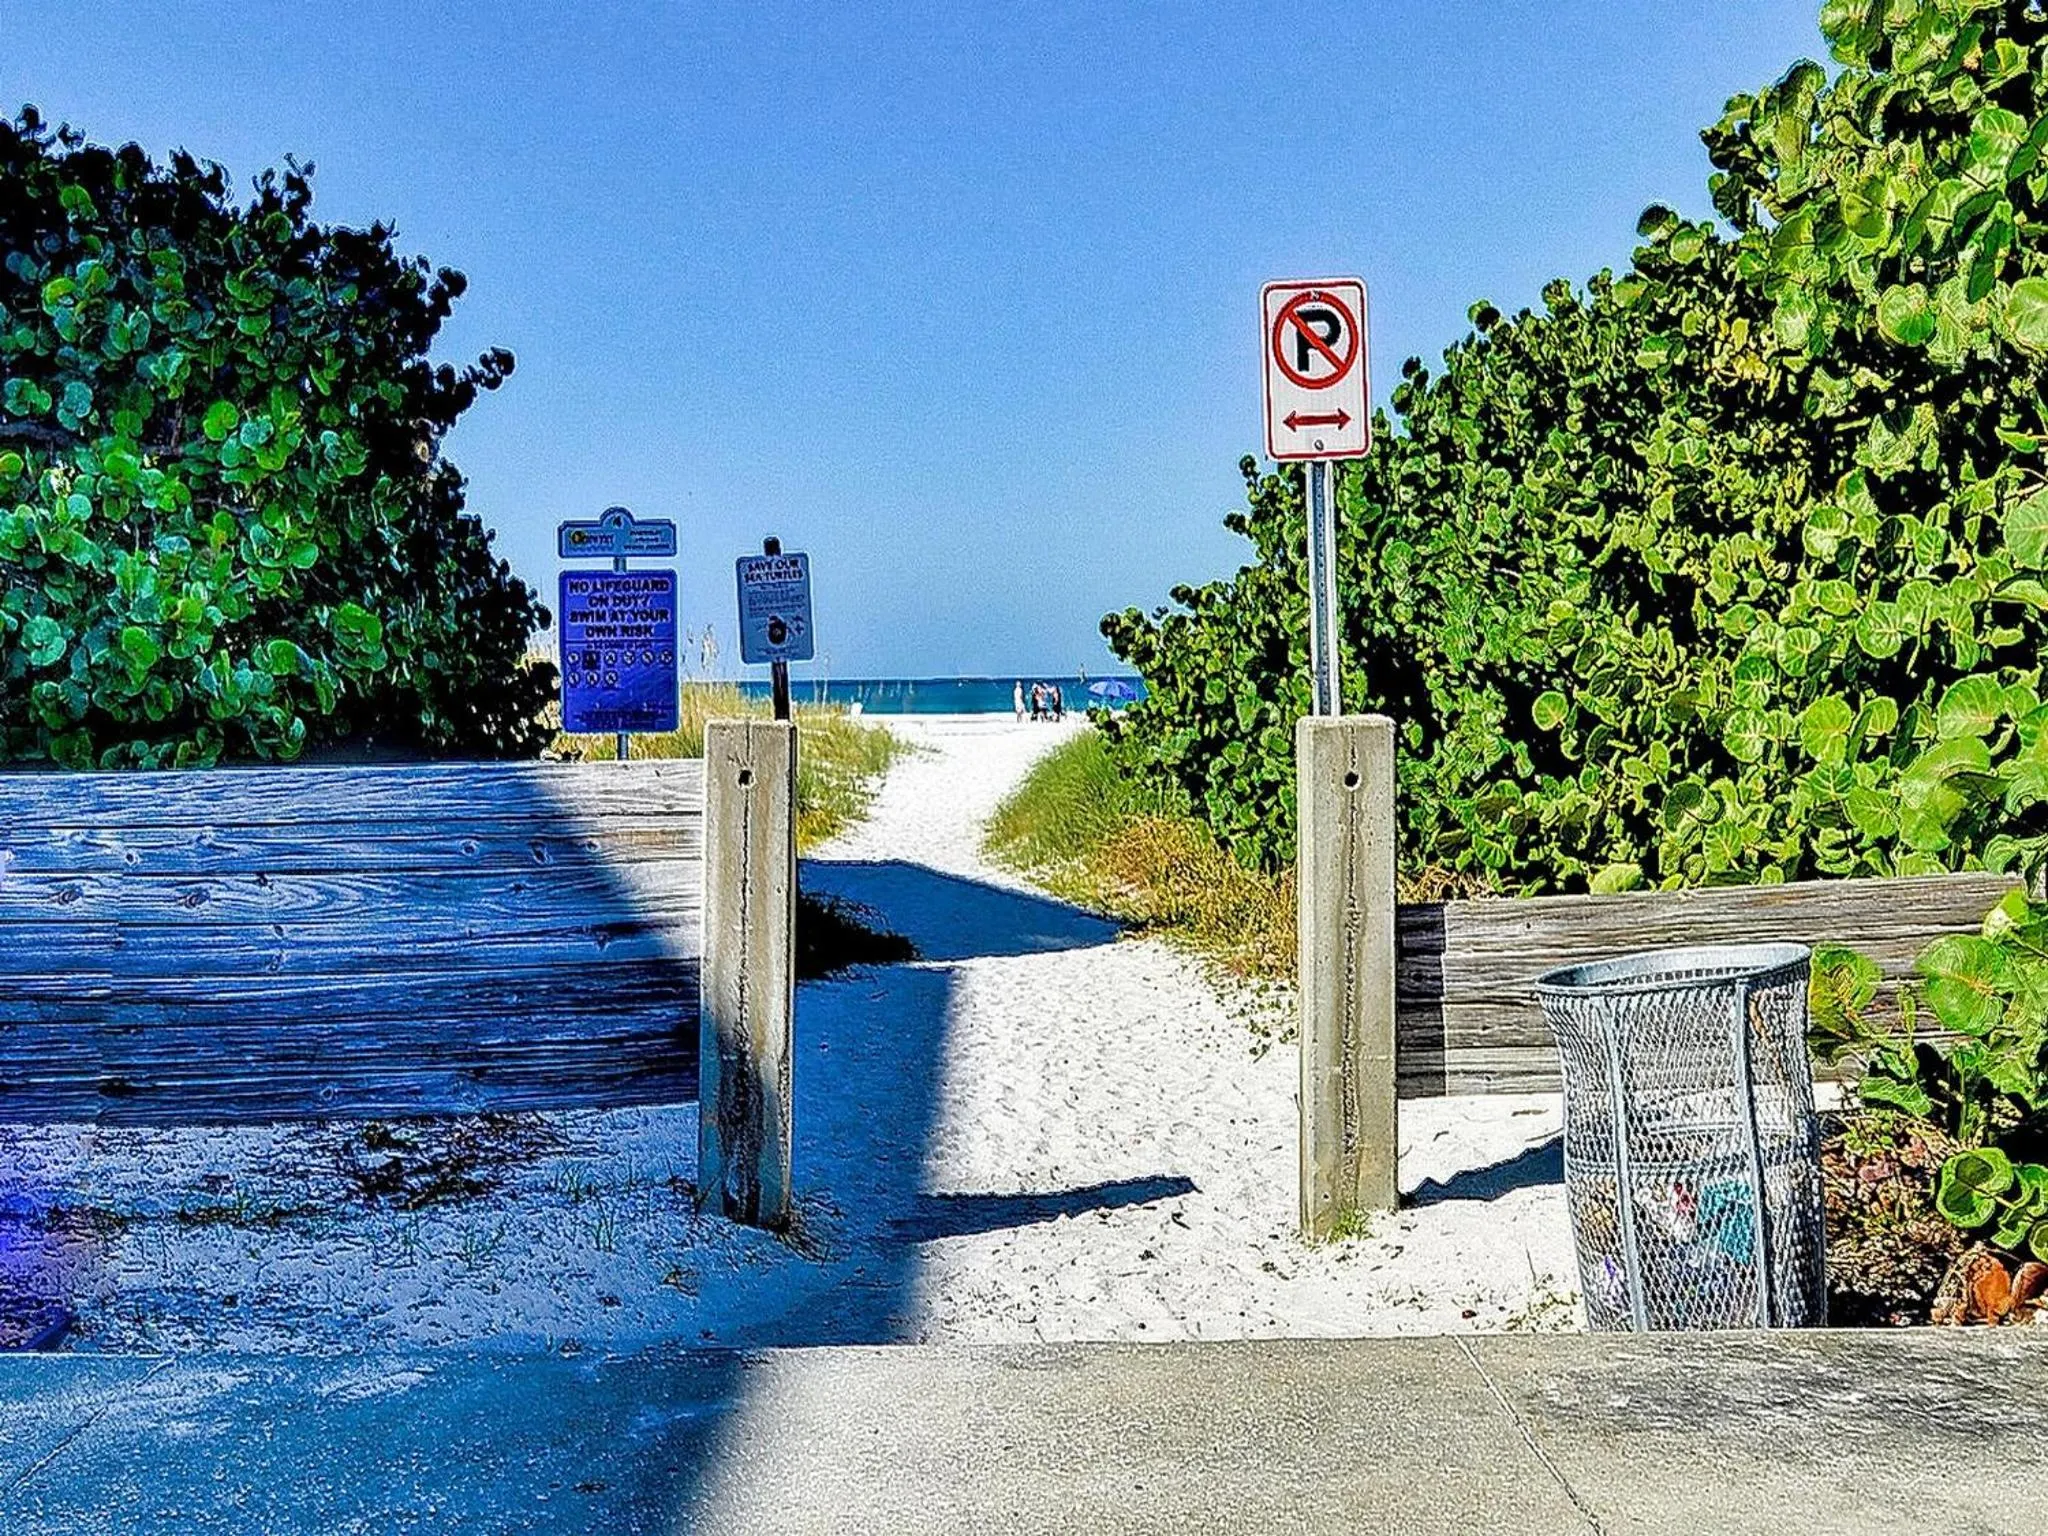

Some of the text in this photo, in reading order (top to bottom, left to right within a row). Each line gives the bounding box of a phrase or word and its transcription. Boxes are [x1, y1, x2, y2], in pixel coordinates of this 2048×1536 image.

[1296, 309, 1341, 371] P
[748, 559, 799, 572] SAVE OUR
[744, 569, 803, 583] SEA TURTLES
[569, 579, 669, 593] NO LIFEGUARD
[588, 595, 609, 607] ON
[569, 608, 669, 623] SWIM AT YOUR
[585, 624, 653, 637] OWN RISK
